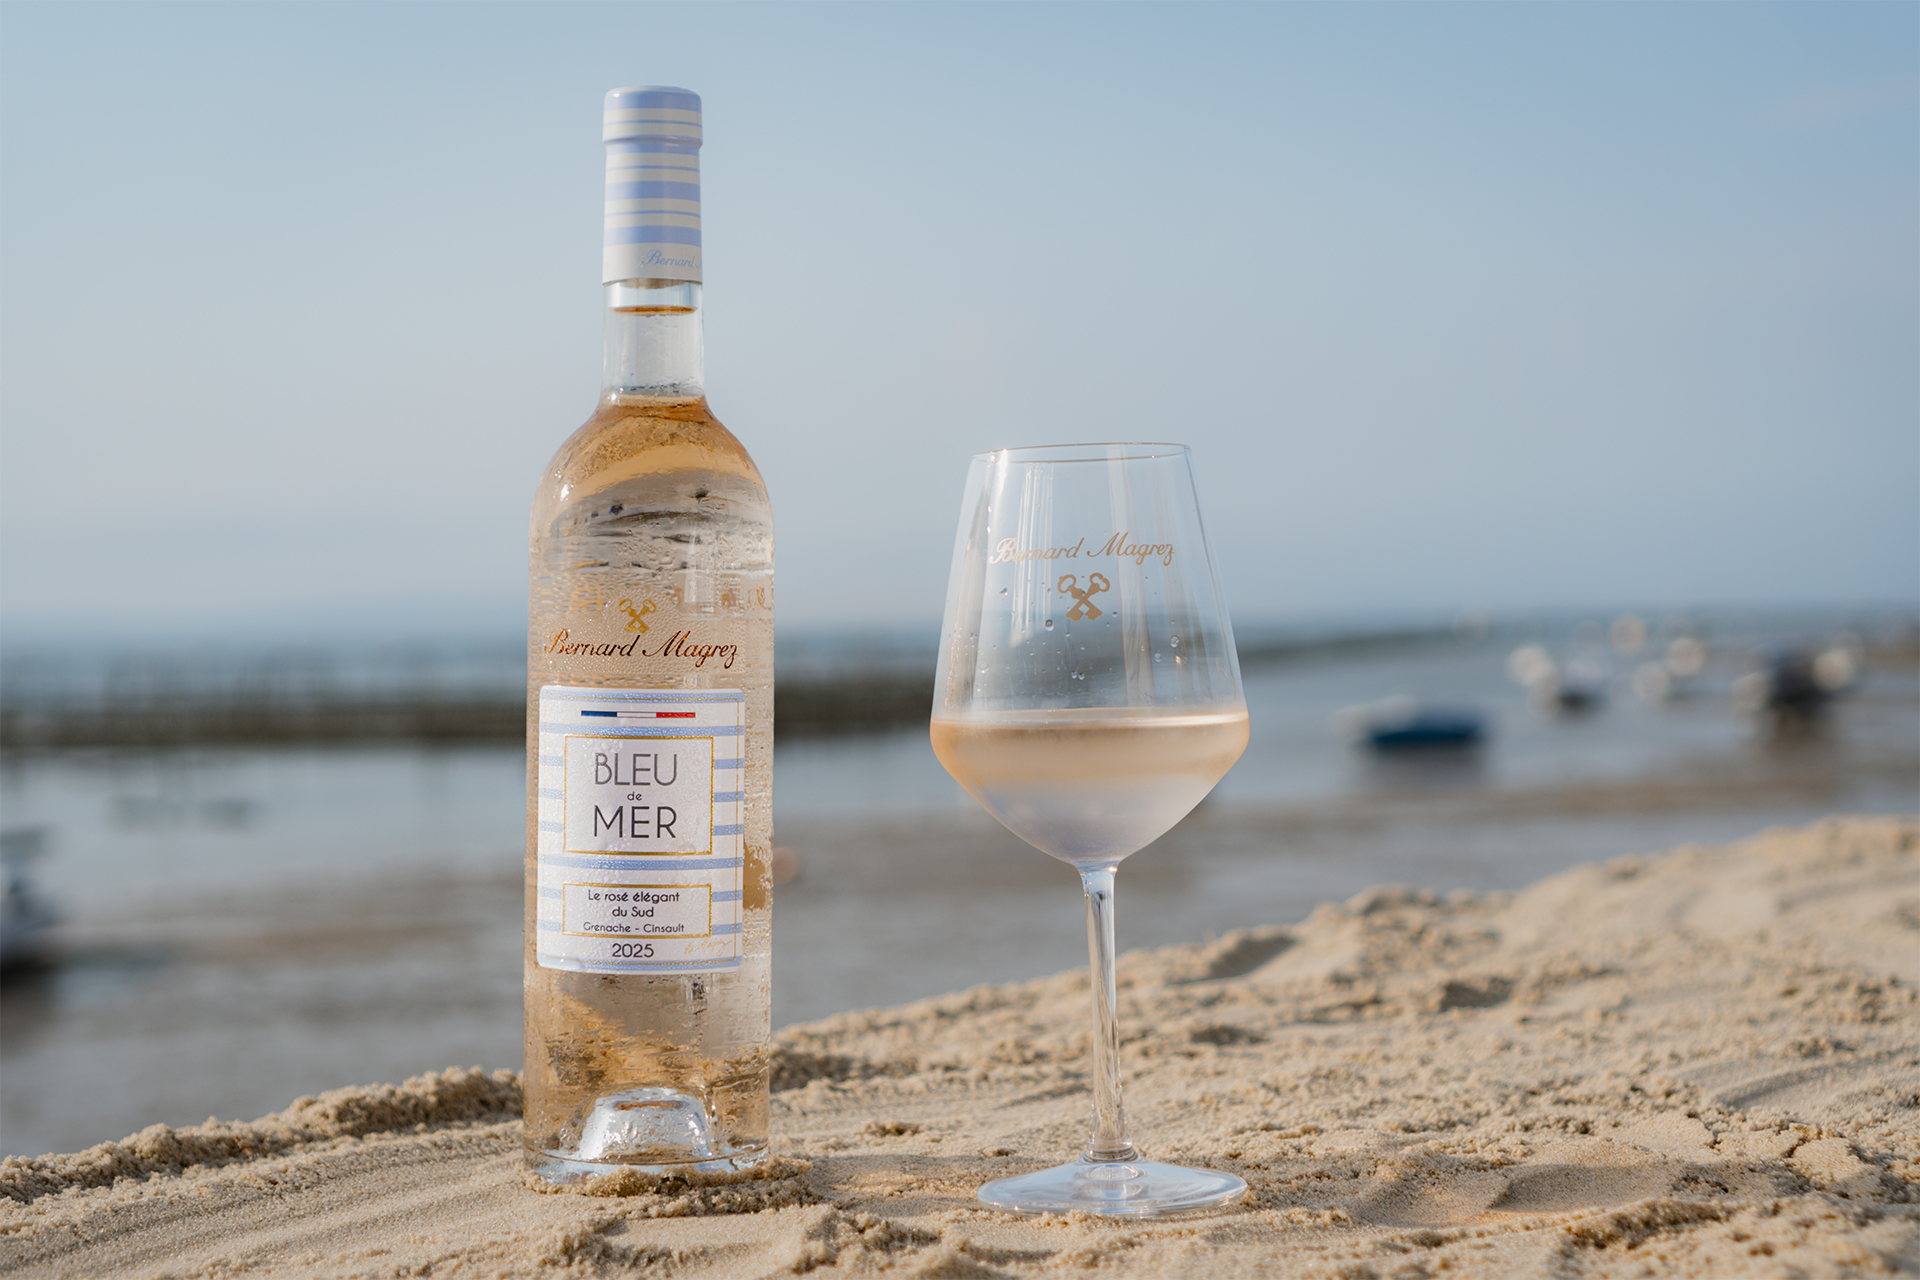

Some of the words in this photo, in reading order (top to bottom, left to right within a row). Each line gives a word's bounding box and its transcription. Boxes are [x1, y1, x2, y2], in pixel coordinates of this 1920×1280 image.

[641, 249, 695, 268] Bernard
[988, 537, 1085, 564] Bernard
[1087, 531, 1175, 566] Magrez
[544, 627, 641, 657] Bernard
[642, 630, 738, 669] Magrez
[595, 753, 677, 786] BLEU
[627, 791, 642, 801] de
[594, 805, 677, 838] MER
[588, 889, 601, 901] Le
[604, 891, 629, 902] rosé
[632, 891, 680, 904] élégant
[612, 906, 628, 917] du
[631, 906, 655, 918] Sud
[583, 921, 631, 933] Grenache
[643, 923, 685, 933] Cinsault
[612, 943, 655, 958] 2025
